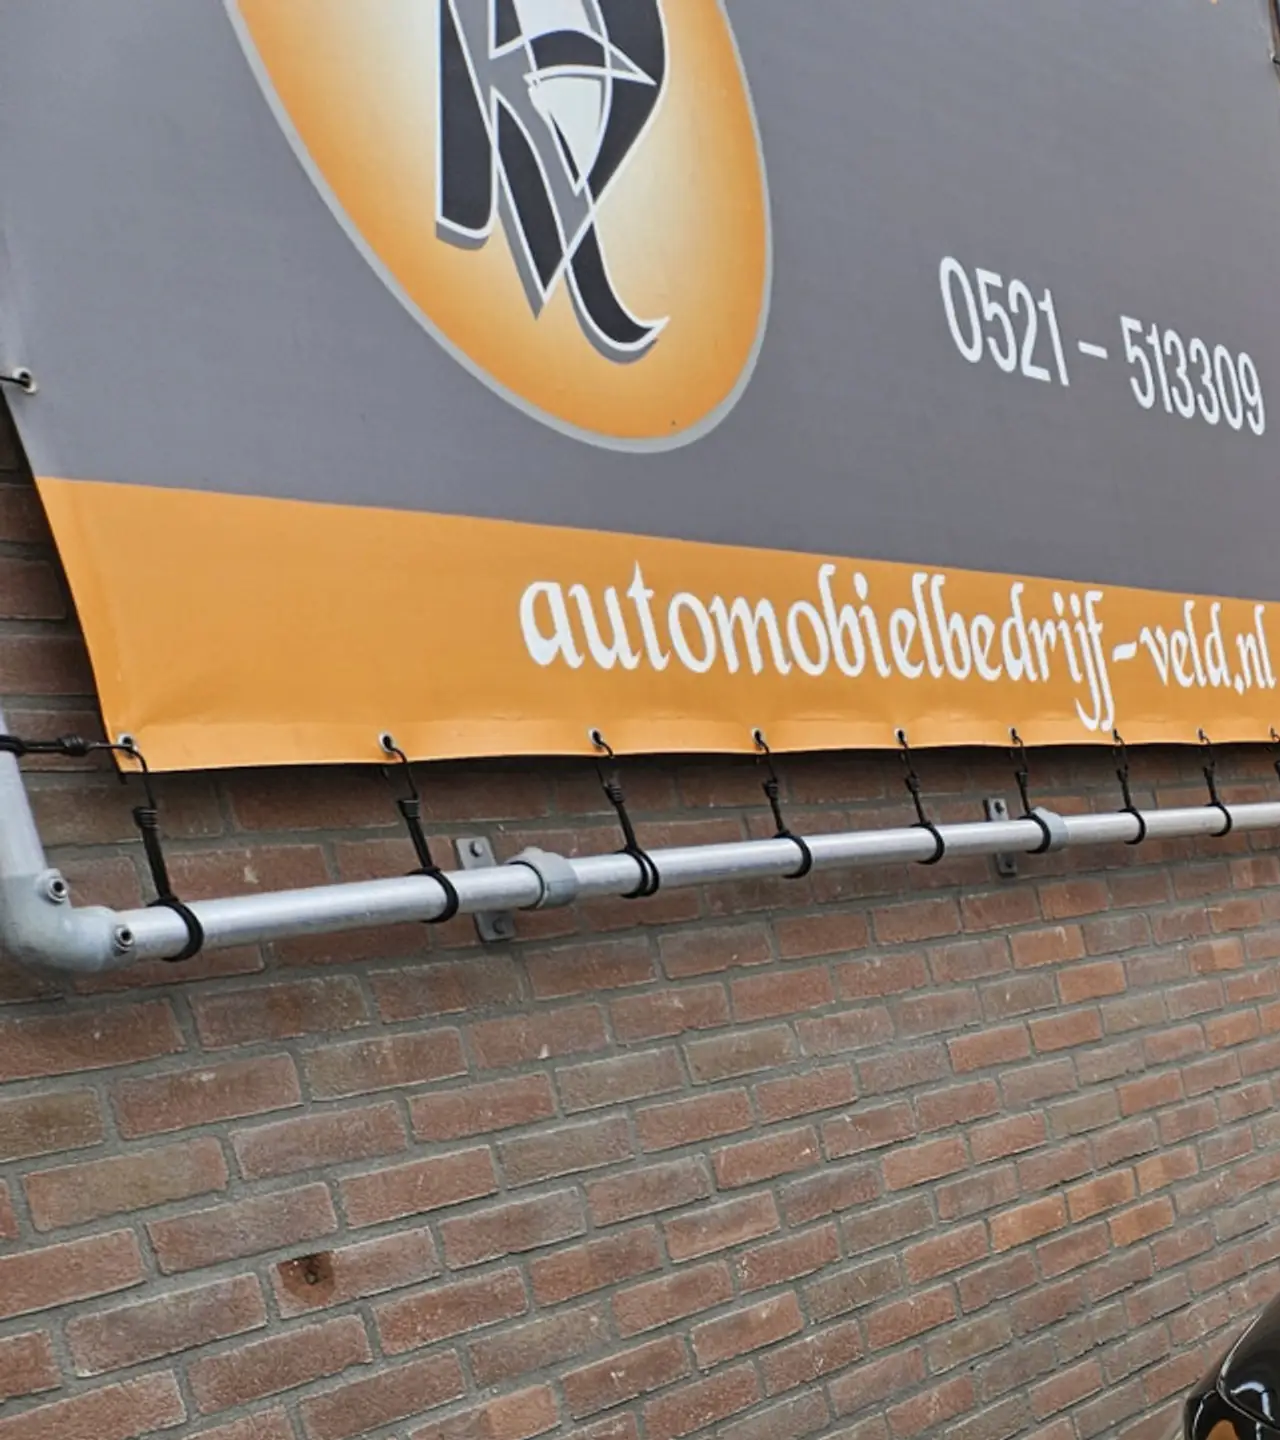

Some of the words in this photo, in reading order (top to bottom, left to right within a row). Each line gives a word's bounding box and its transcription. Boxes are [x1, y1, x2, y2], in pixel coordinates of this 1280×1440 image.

[938, 255, 1070, 387] 0521
[1119, 314, 1267, 437] 513309
[518, 562, 1279, 734] automobielbedrijf-veld.nl
